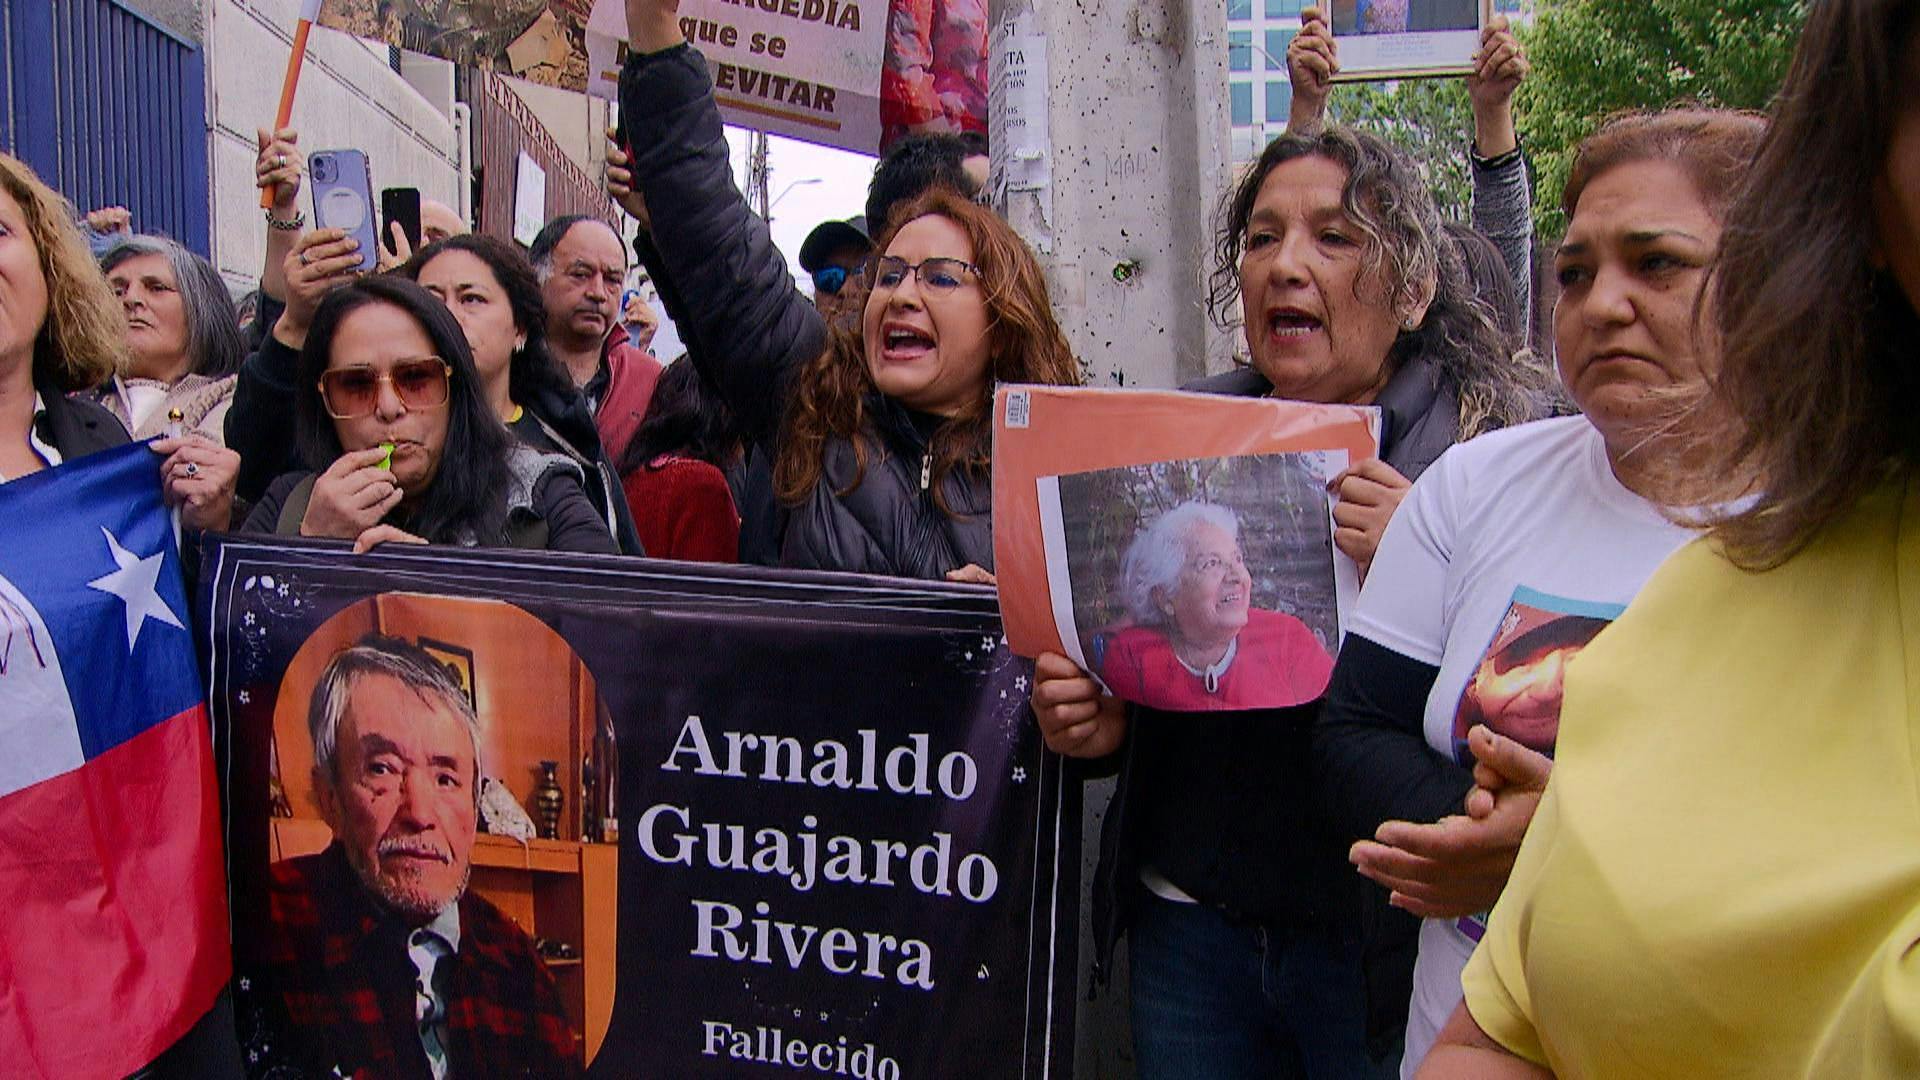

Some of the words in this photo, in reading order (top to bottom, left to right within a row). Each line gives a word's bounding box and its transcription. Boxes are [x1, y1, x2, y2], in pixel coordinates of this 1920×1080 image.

[679, 16, 738, 48] que
[750, 30, 787, 59] se
[715, 62, 837, 113] EVITAR
[660, 714, 978, 801] Arnaldo
[637, 803, 999, 903] Guajardo
[690, 900, 935, 991] Rivera
[701, 1020, 901, 1080] Fallecido
